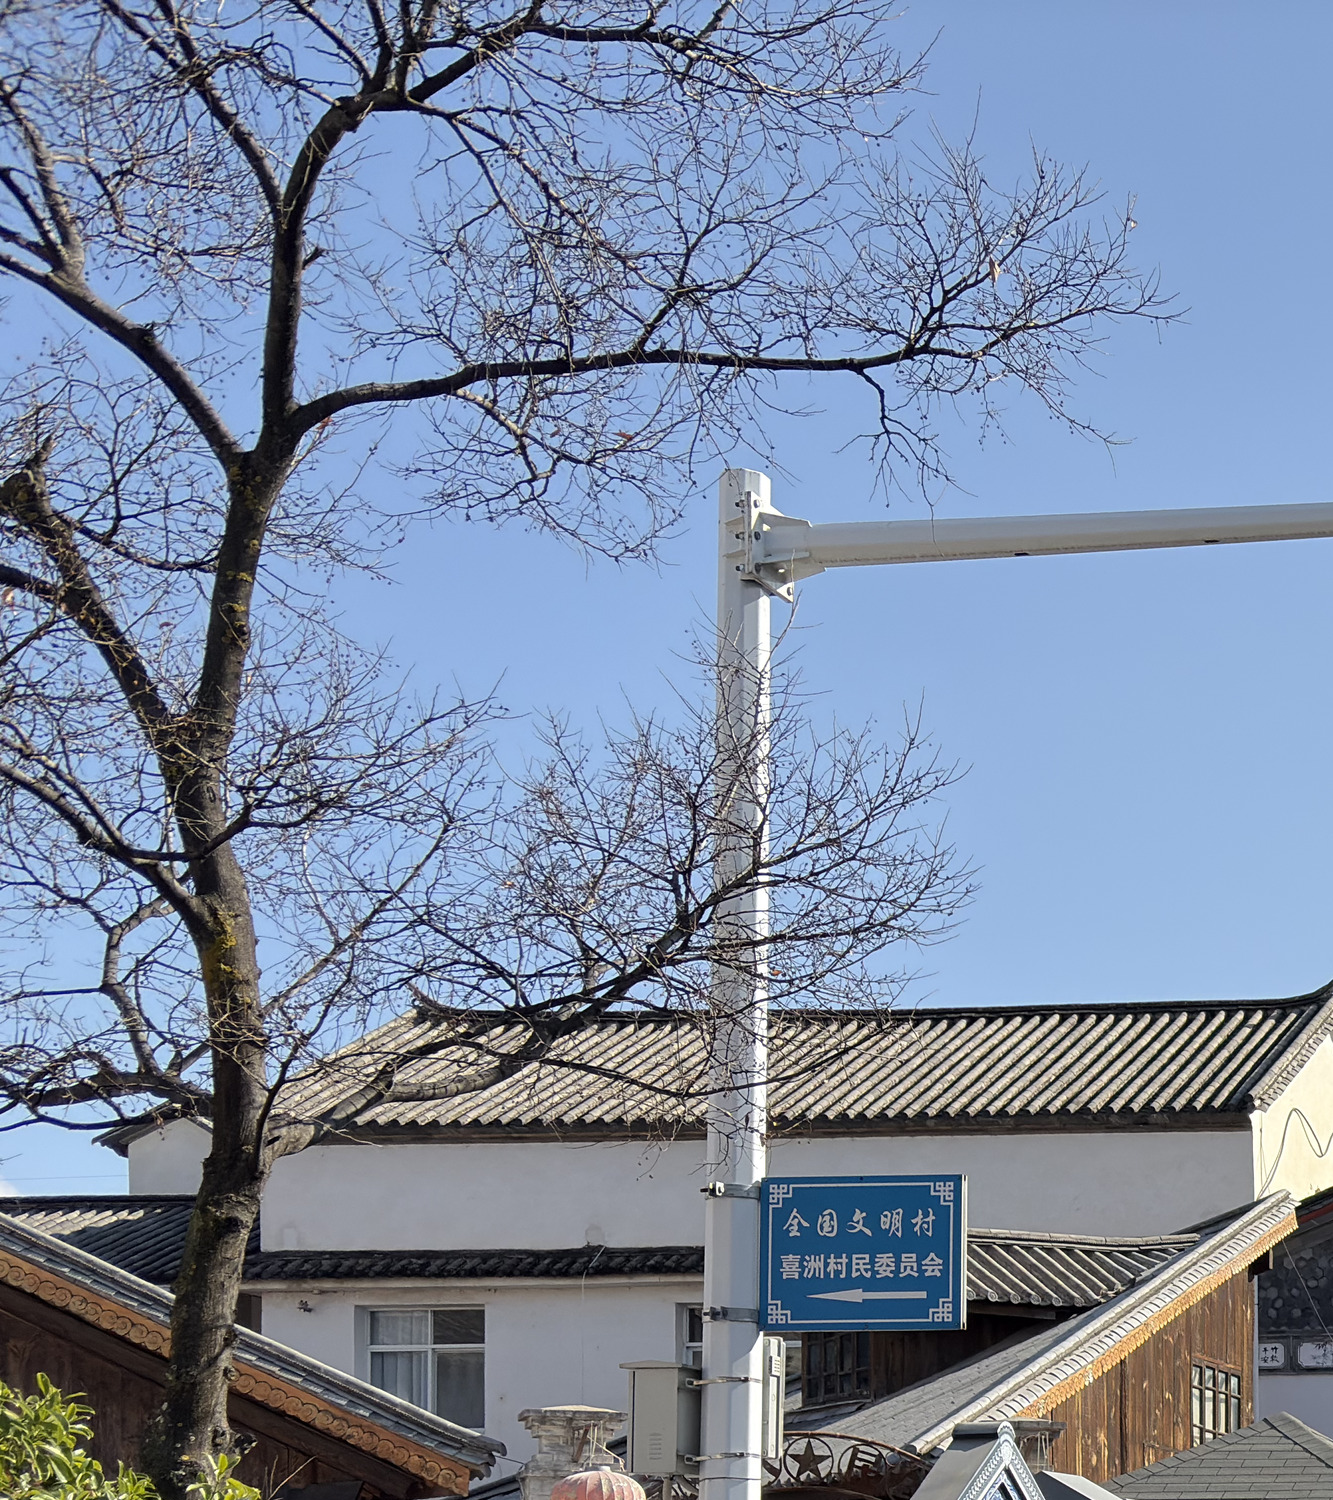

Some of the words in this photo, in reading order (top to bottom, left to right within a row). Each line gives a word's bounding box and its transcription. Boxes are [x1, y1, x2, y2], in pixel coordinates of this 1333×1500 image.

[783, 1208, 936, 1238] 全国文明村
[780, 1252, 943, 1279] 喜洲村民委员会
